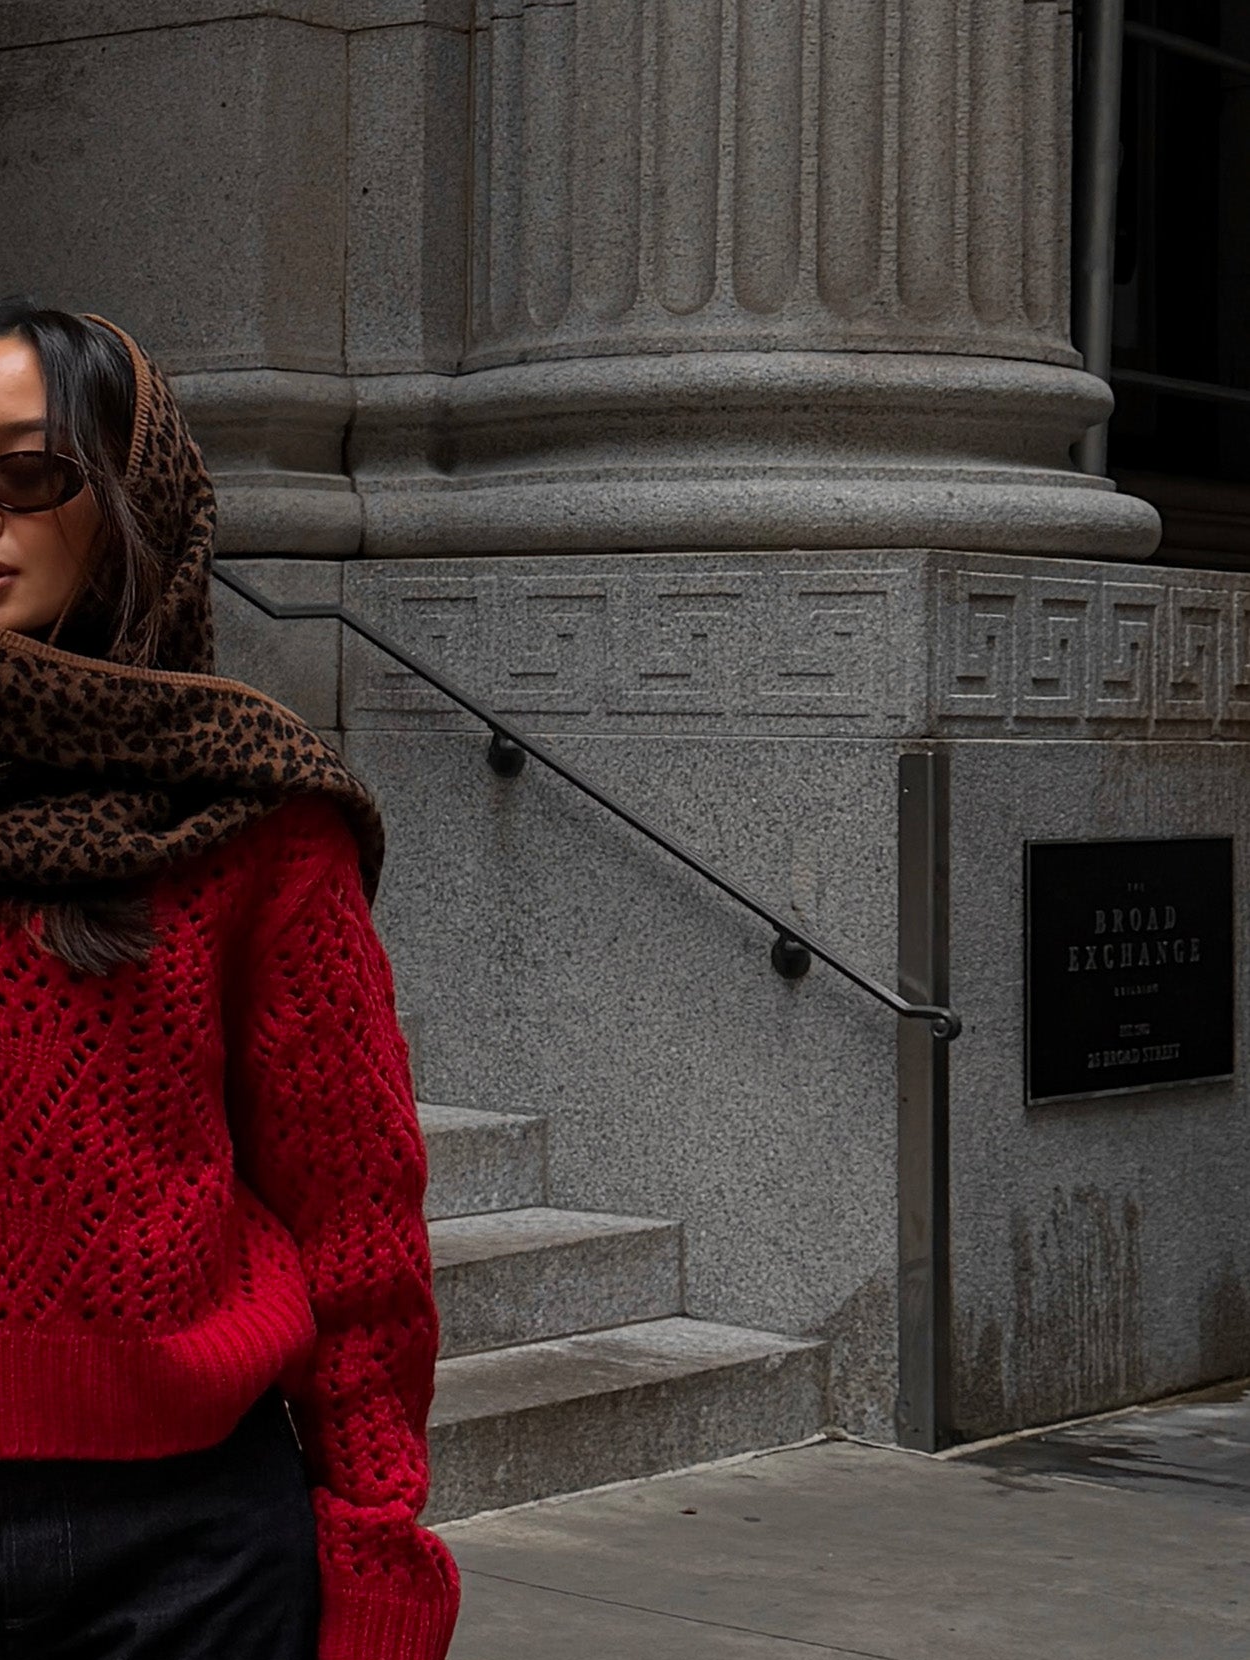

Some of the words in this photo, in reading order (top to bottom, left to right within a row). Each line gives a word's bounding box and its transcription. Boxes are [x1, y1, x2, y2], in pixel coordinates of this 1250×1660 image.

[1094, 906, 1177, 934] BROAD
[1067, 937, 1201, 972] EXCHANGE
[1102, 1048, 1140, 1068] BROAD
[1142, 1043, 1182, 1063] STREET
